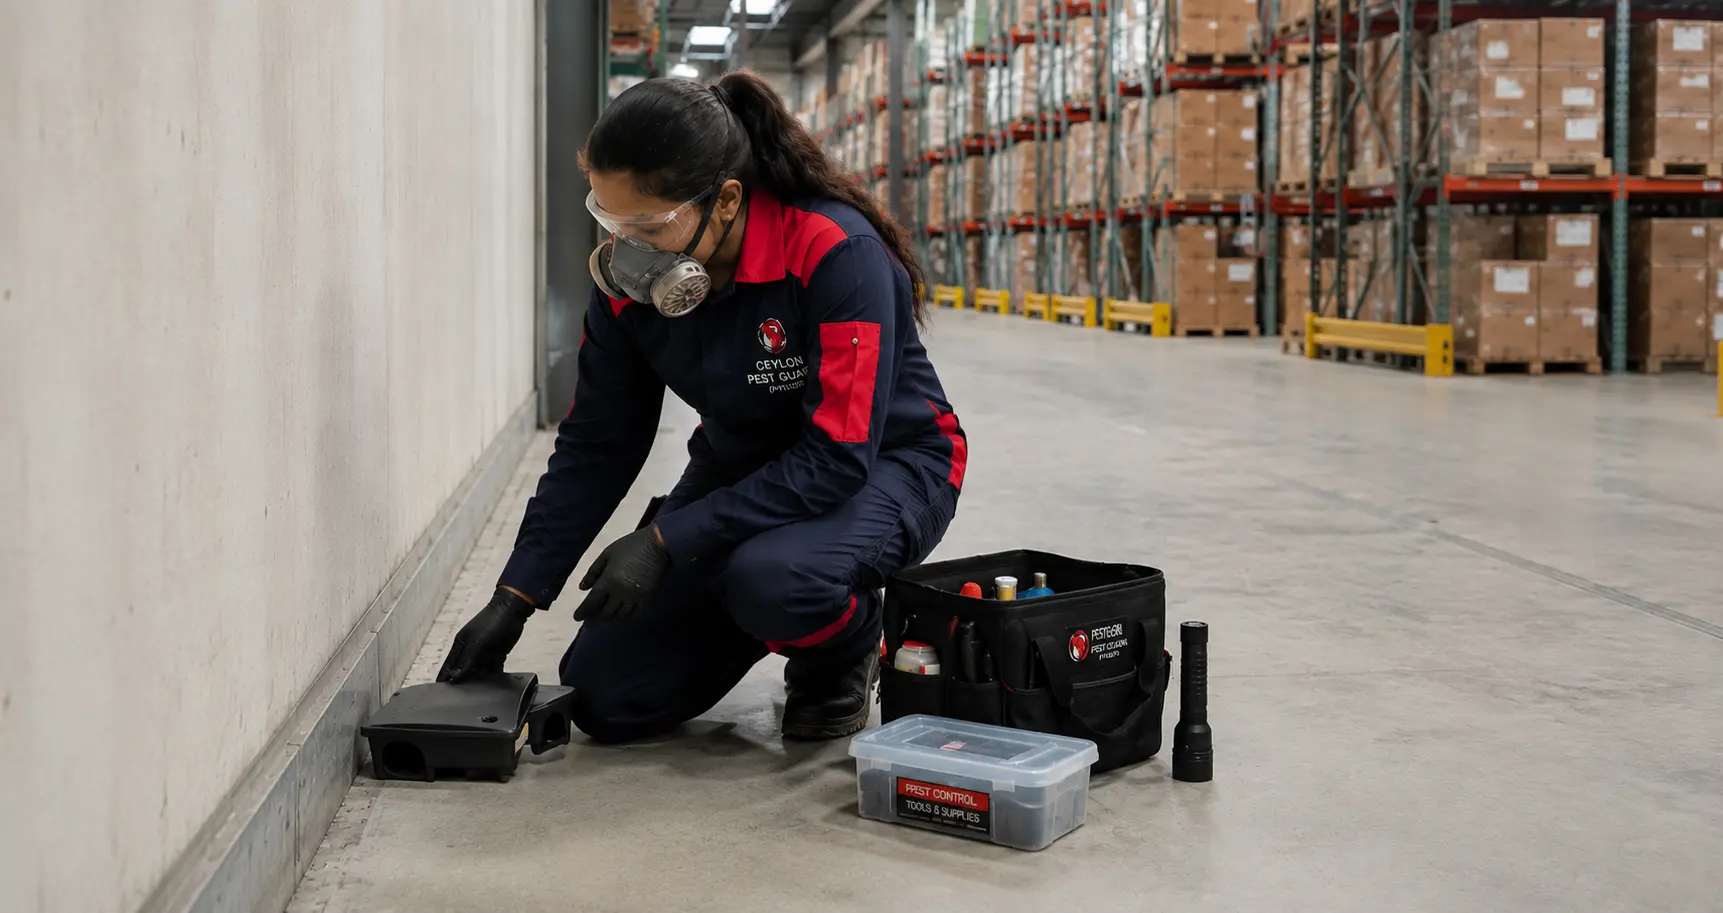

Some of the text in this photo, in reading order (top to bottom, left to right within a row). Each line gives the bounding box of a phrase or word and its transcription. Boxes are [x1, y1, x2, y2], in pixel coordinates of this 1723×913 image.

[756, 356, 804, 371] CEYLON
[747, 373, 775, 385] PEST
[932, 788, 978, 807] CONTROL
[906, 800, 932, 814] TOOLS
[941, 806, 980, 824] SUPPLIES
